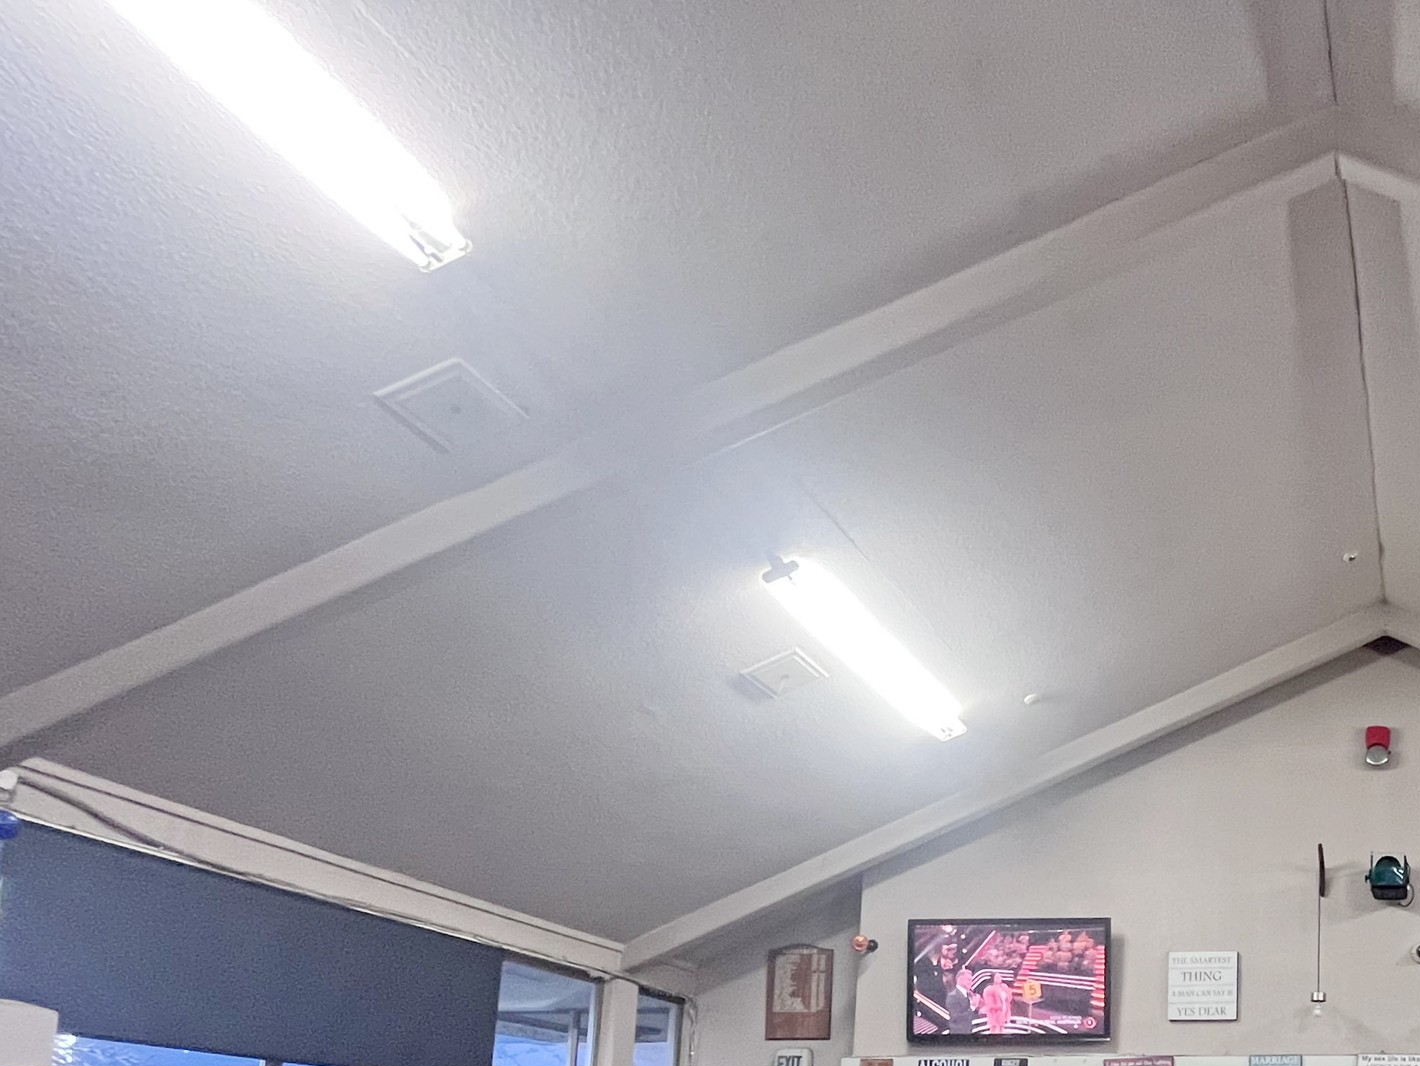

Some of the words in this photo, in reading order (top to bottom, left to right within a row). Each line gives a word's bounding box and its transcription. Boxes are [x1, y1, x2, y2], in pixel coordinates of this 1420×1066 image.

[1181, 970, 1222, 982] THING
[1177, 1008, 1196, 1016] YES
[1198, 1006, 1227, 1016] DEAR
